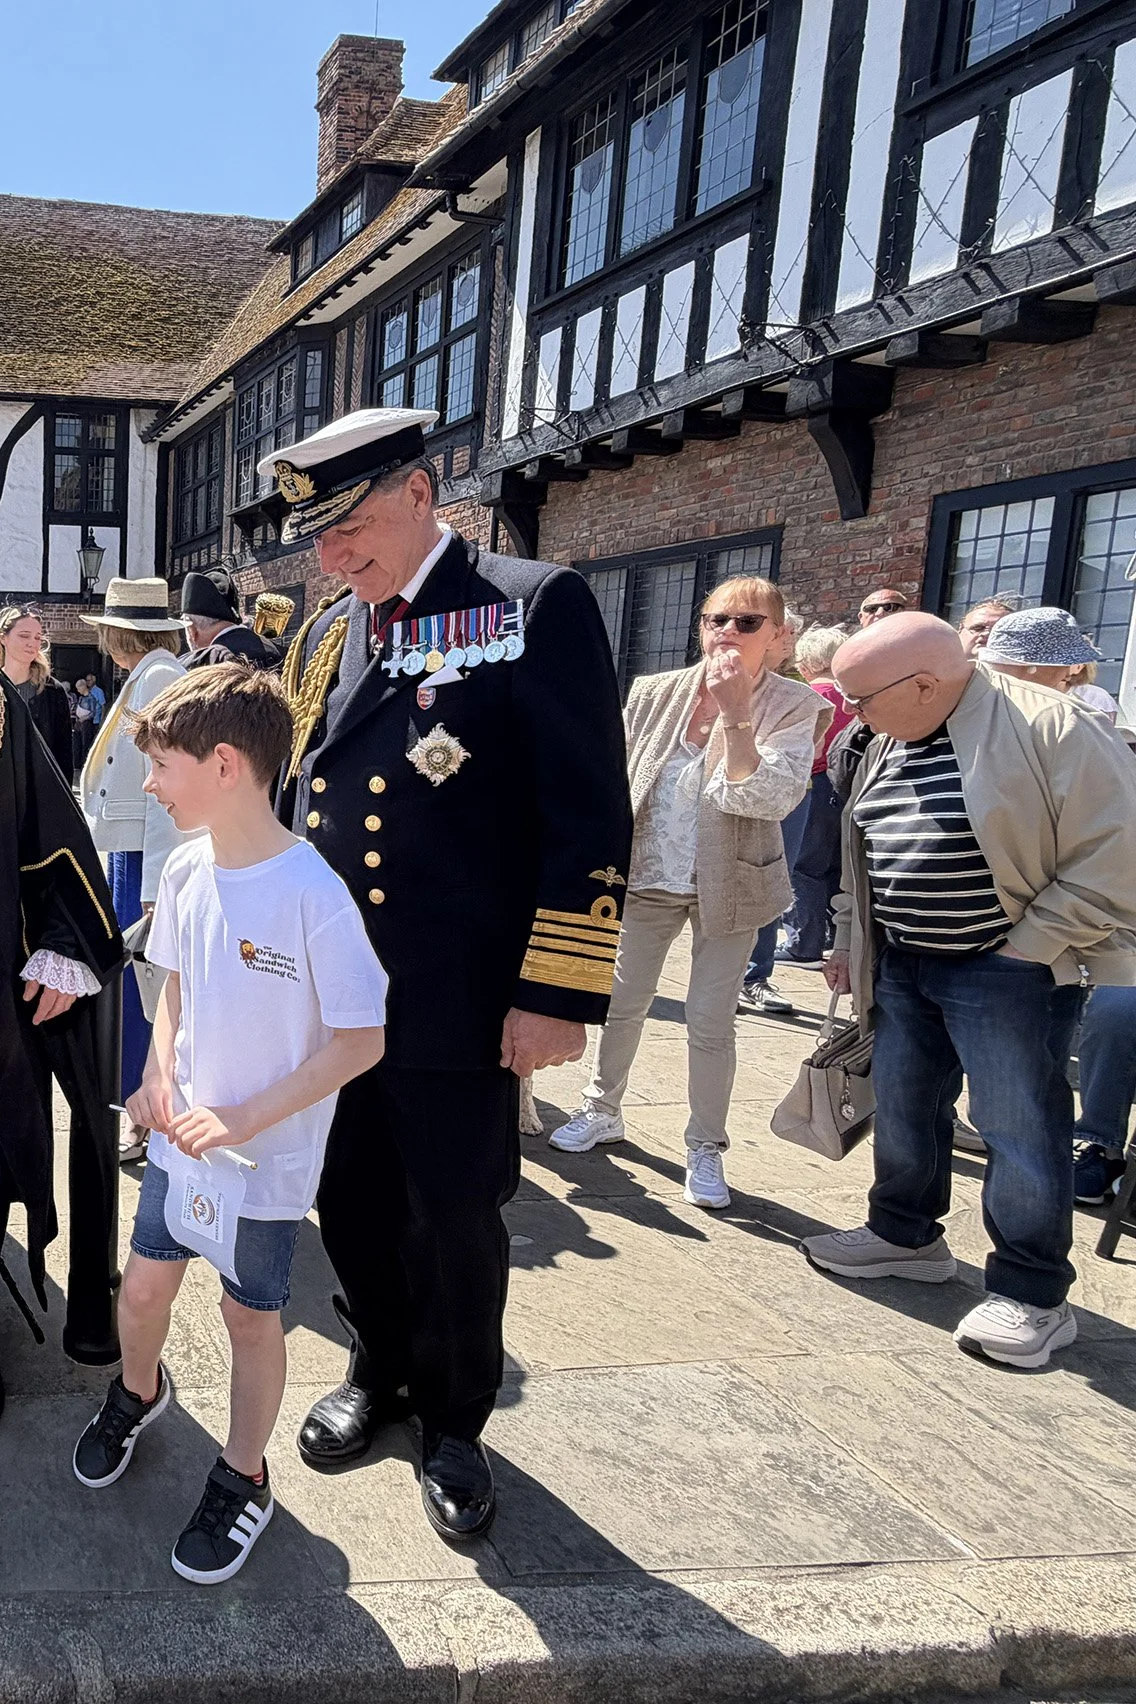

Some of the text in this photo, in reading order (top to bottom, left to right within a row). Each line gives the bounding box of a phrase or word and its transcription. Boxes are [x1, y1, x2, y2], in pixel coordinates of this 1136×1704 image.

[255, 947, 295, 964] Original
[246, 962, 286, 978] Clothing
[254, 956, 297, 973] Sandwich
